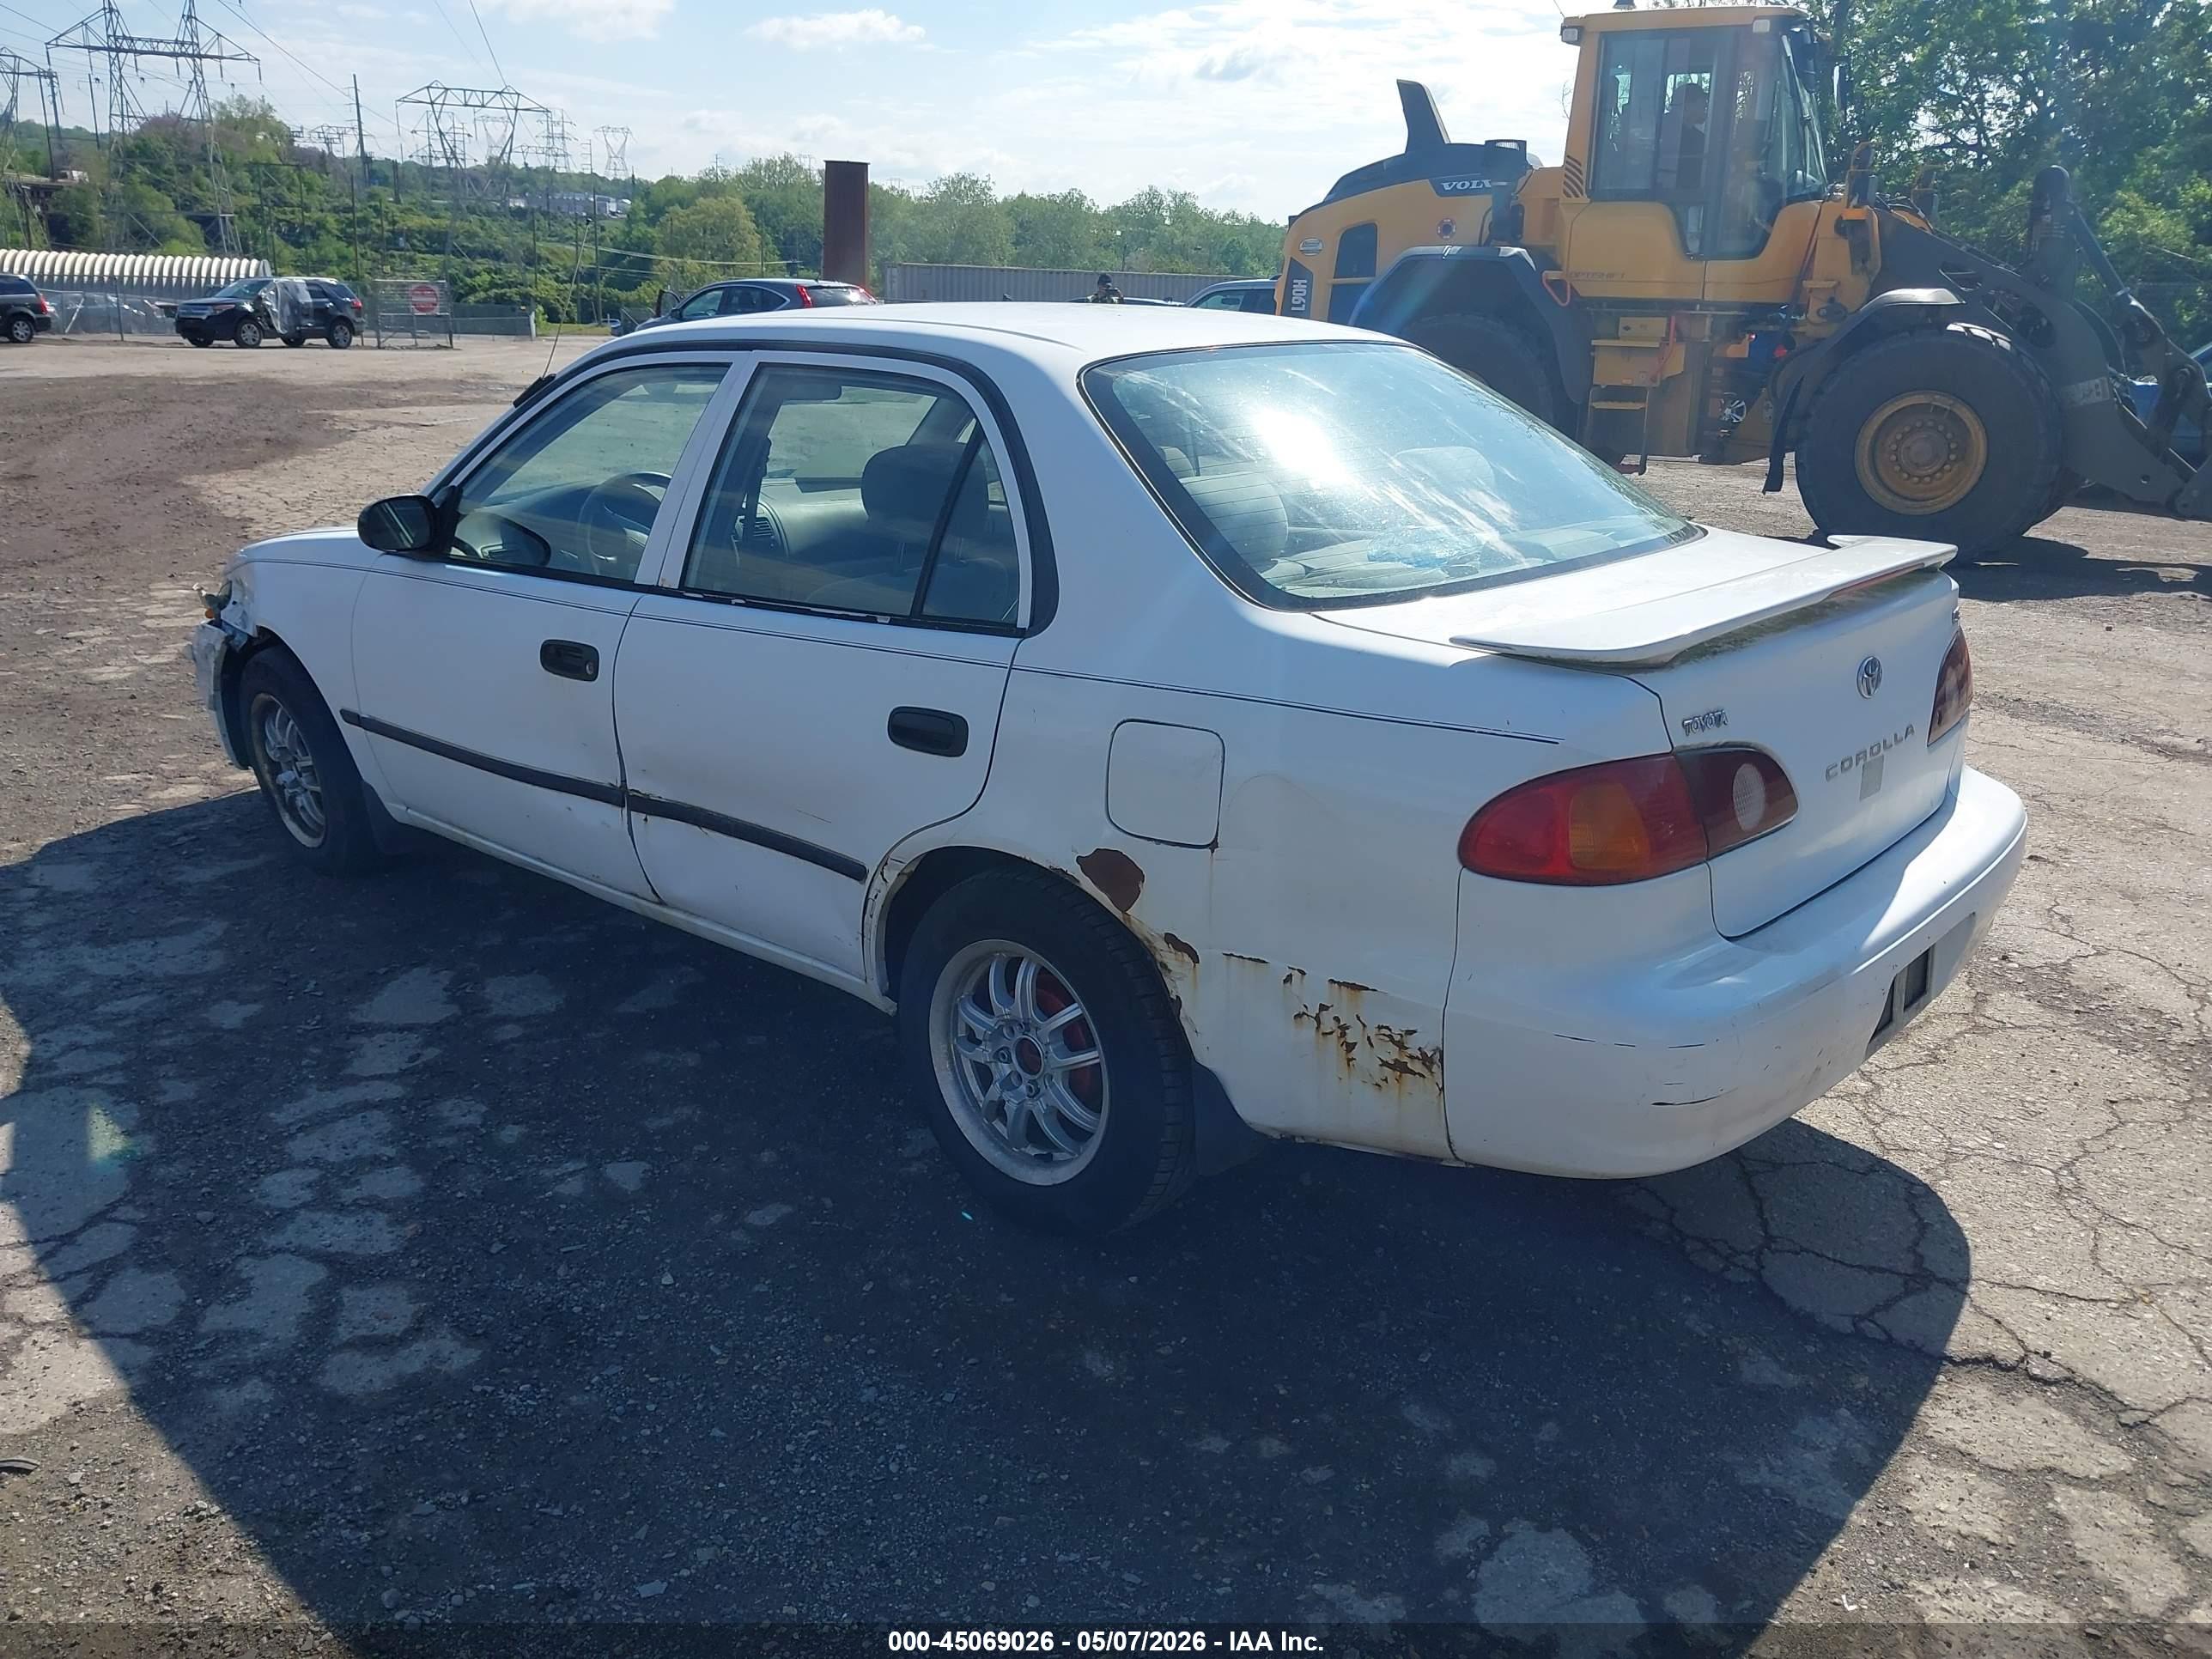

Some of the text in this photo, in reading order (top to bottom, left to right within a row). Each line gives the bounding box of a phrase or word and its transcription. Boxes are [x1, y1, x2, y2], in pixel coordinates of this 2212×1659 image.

[1441, 179, 1492, 191] VOLV
[1291, 279, 1307, 311] L90H
[1682, 709, 1729, 736] TOYOTA
[1825, 723, 1915, 782] COROLLA
